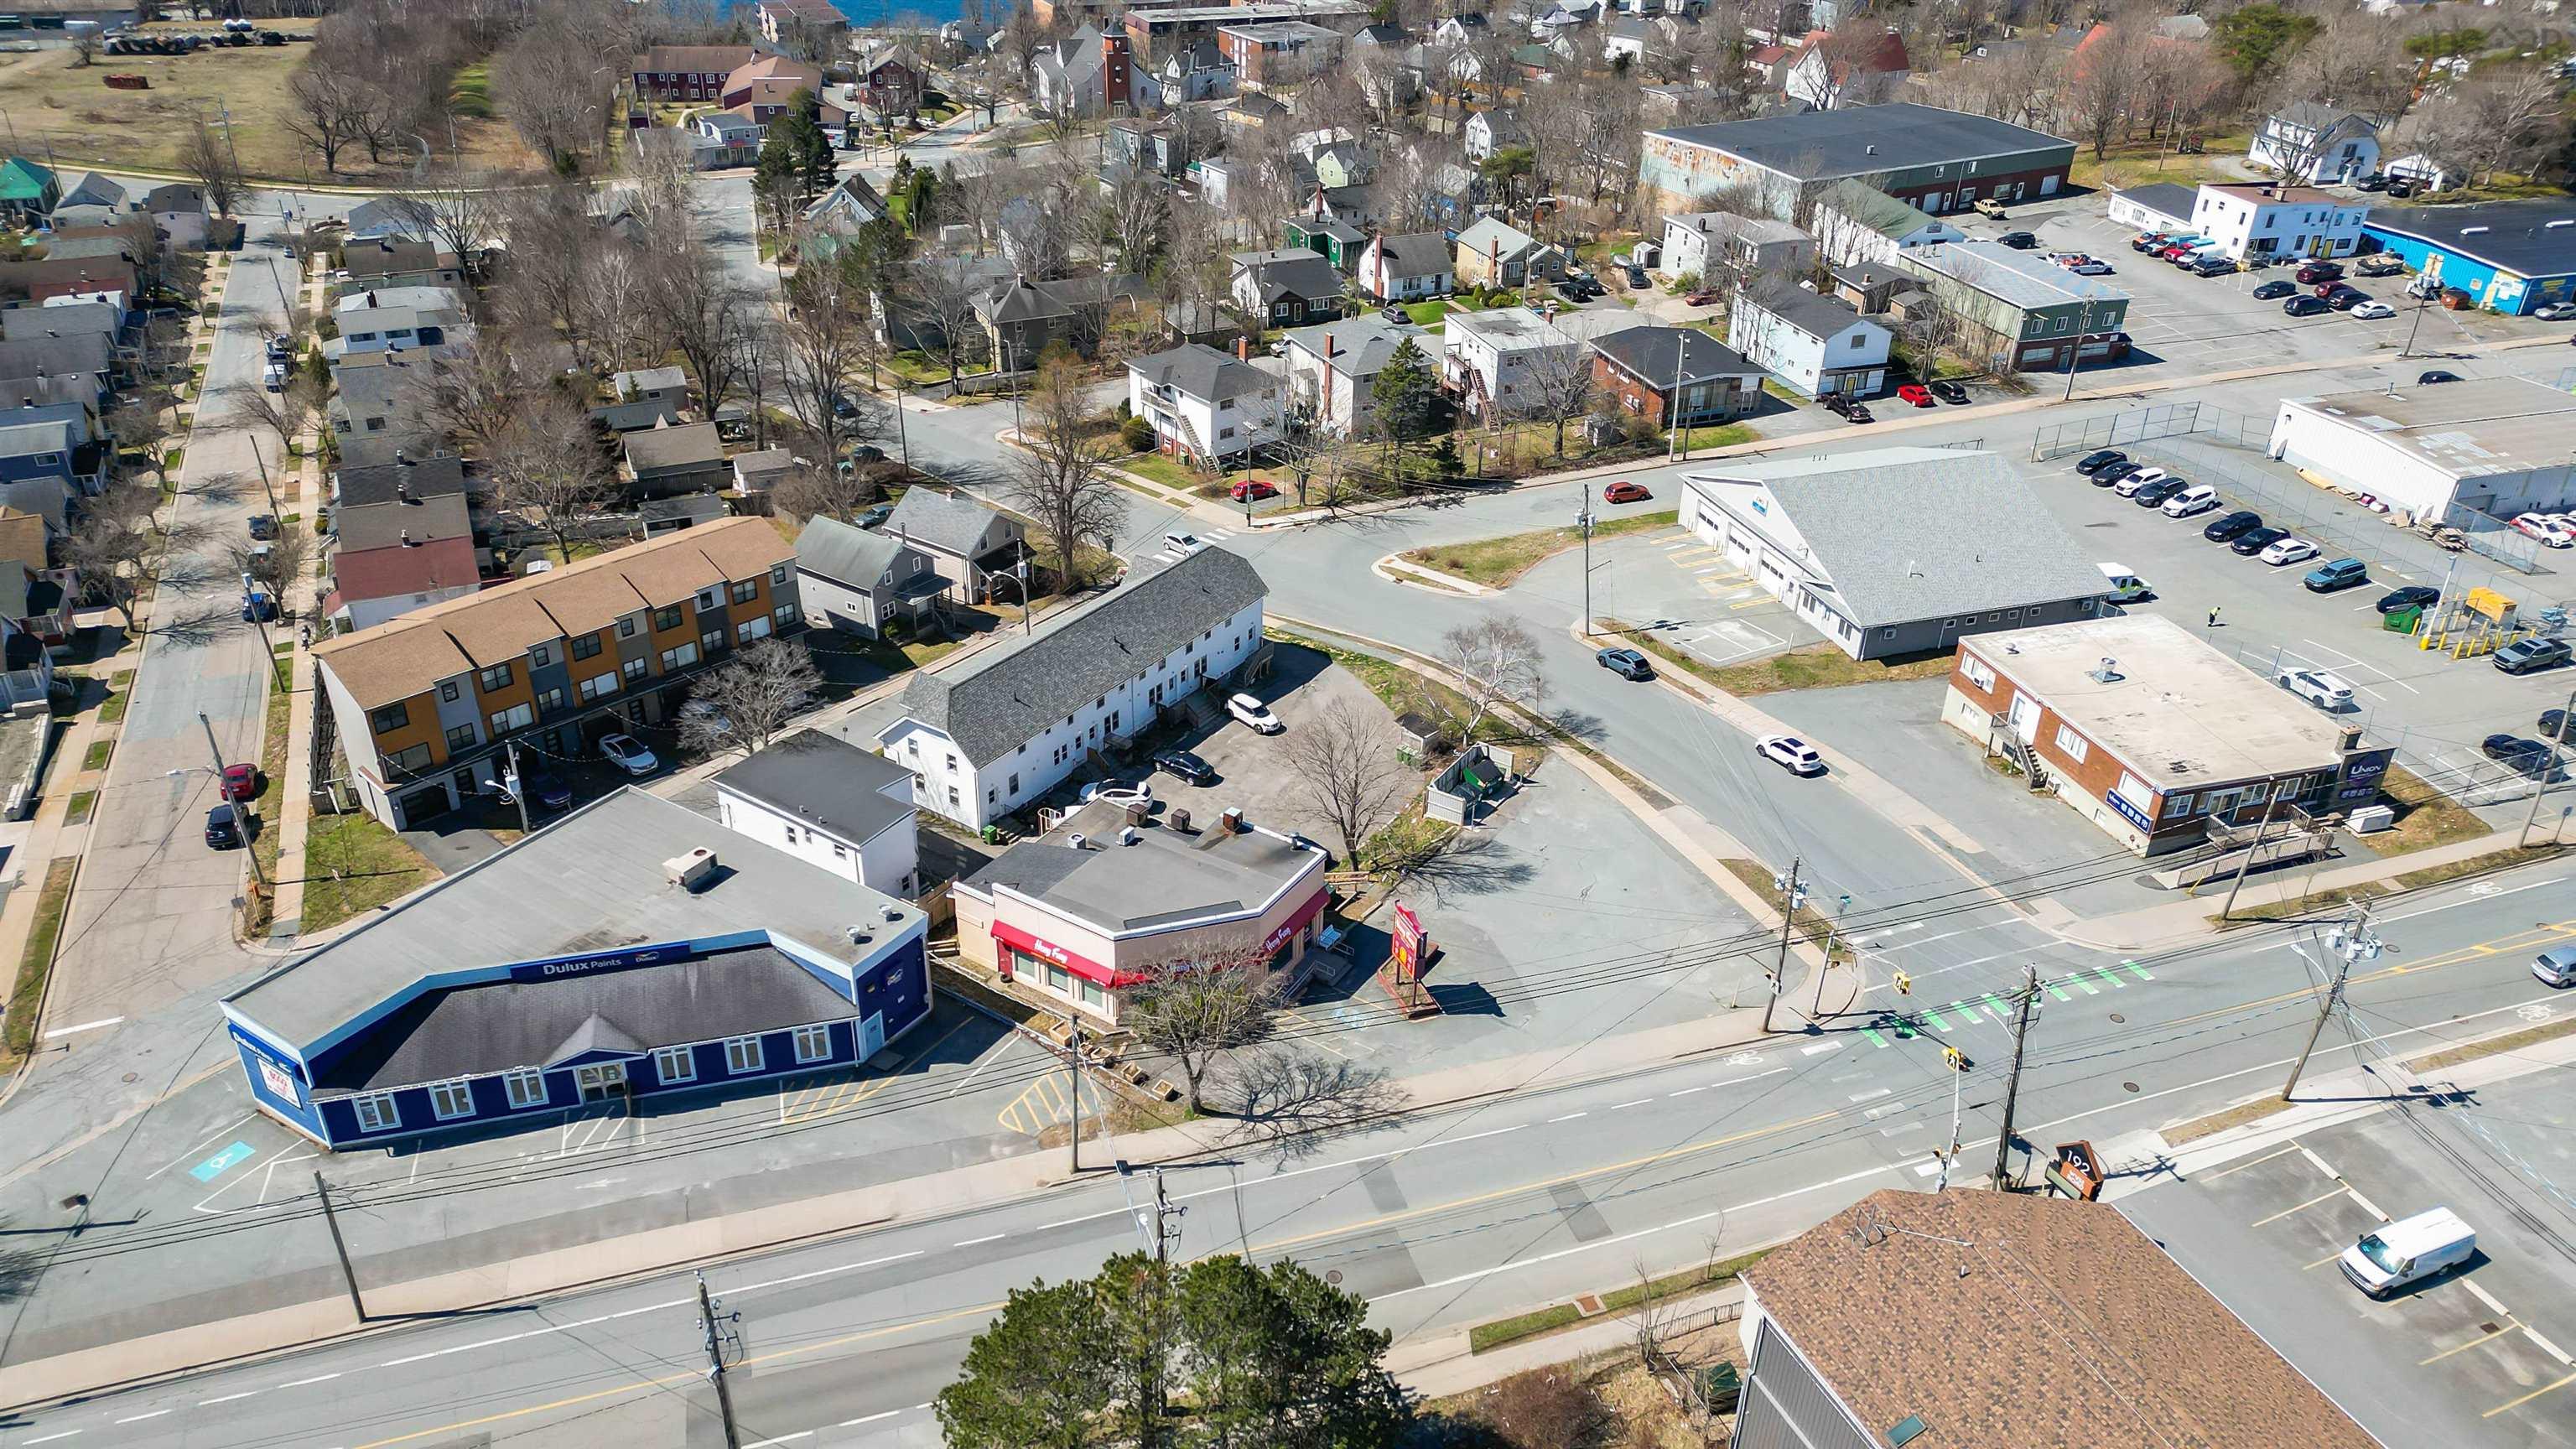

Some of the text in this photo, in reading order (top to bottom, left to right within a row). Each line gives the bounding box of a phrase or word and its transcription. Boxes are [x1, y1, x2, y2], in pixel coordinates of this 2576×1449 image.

[543, 958, 622, 974] Dulux Paints
[2067, 1150, 2090, 1176] 192
